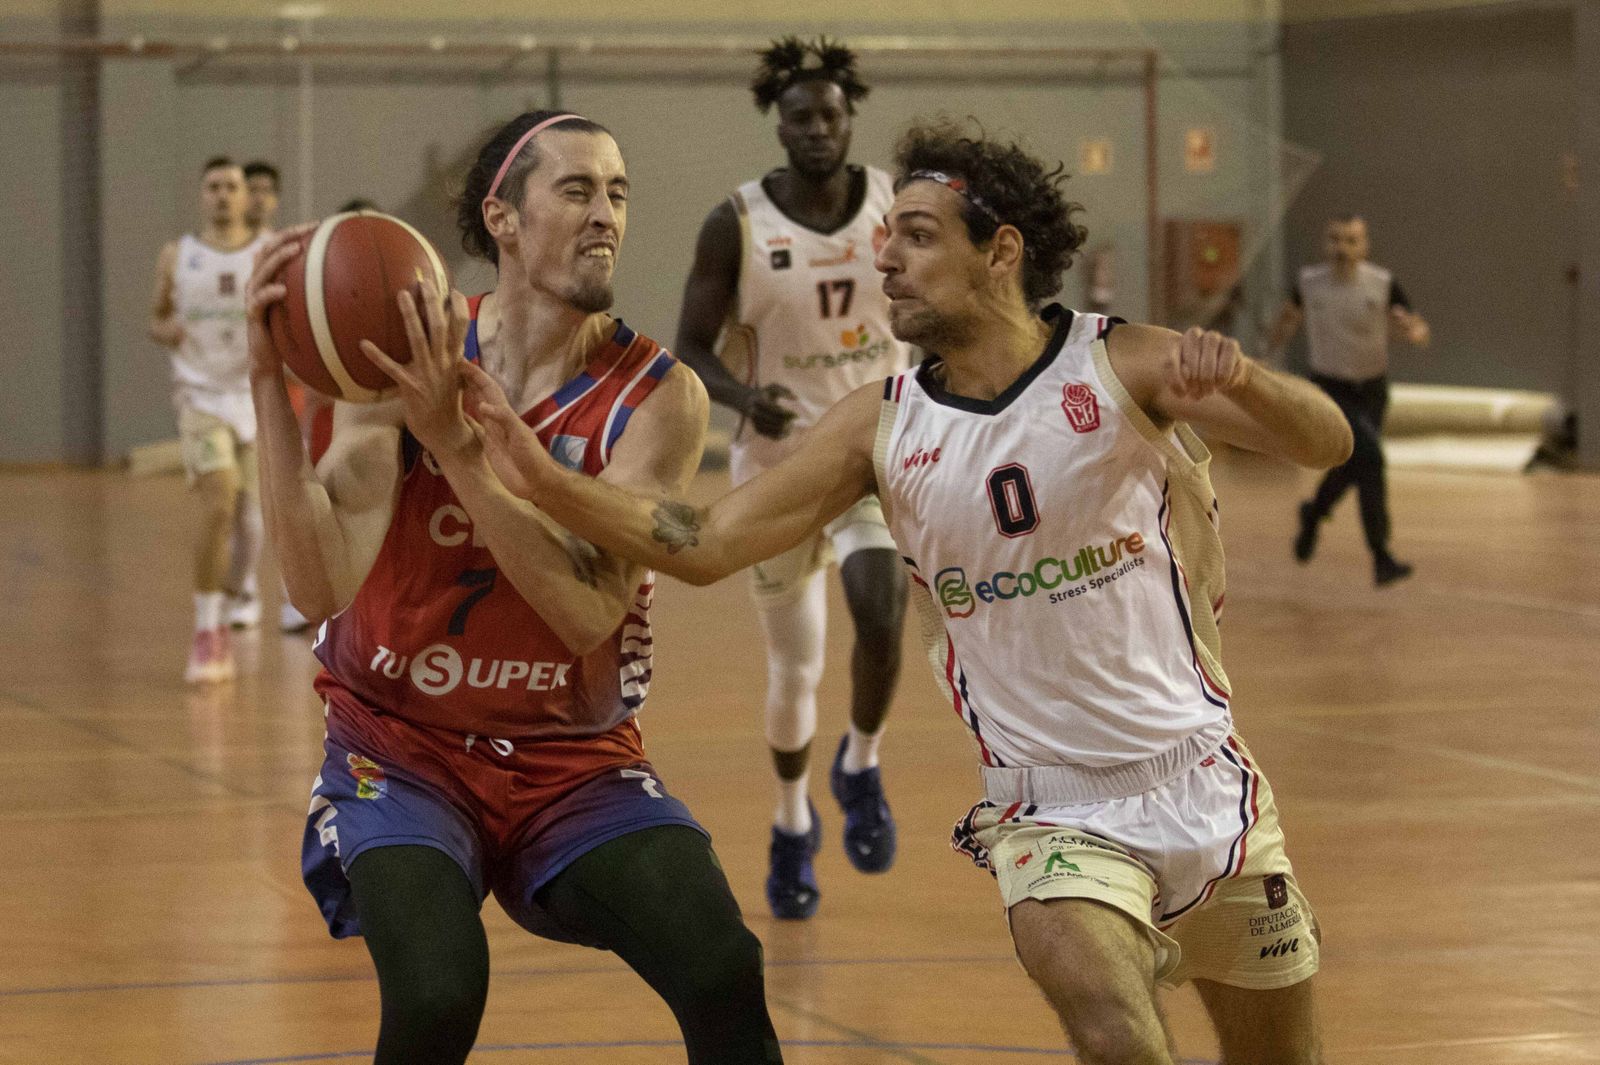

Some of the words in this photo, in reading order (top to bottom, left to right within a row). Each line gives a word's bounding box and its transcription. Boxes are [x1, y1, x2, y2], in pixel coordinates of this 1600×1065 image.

[817, 277, 856, 319] 17
[985, 461, 1042, 539] 0
[447, 567, 498, 637] 7
[1049, 583, 1088, 605] Stress
[1089, 556, 1146, 592] Specialists
[1250, 926, 1266, 937] DE
